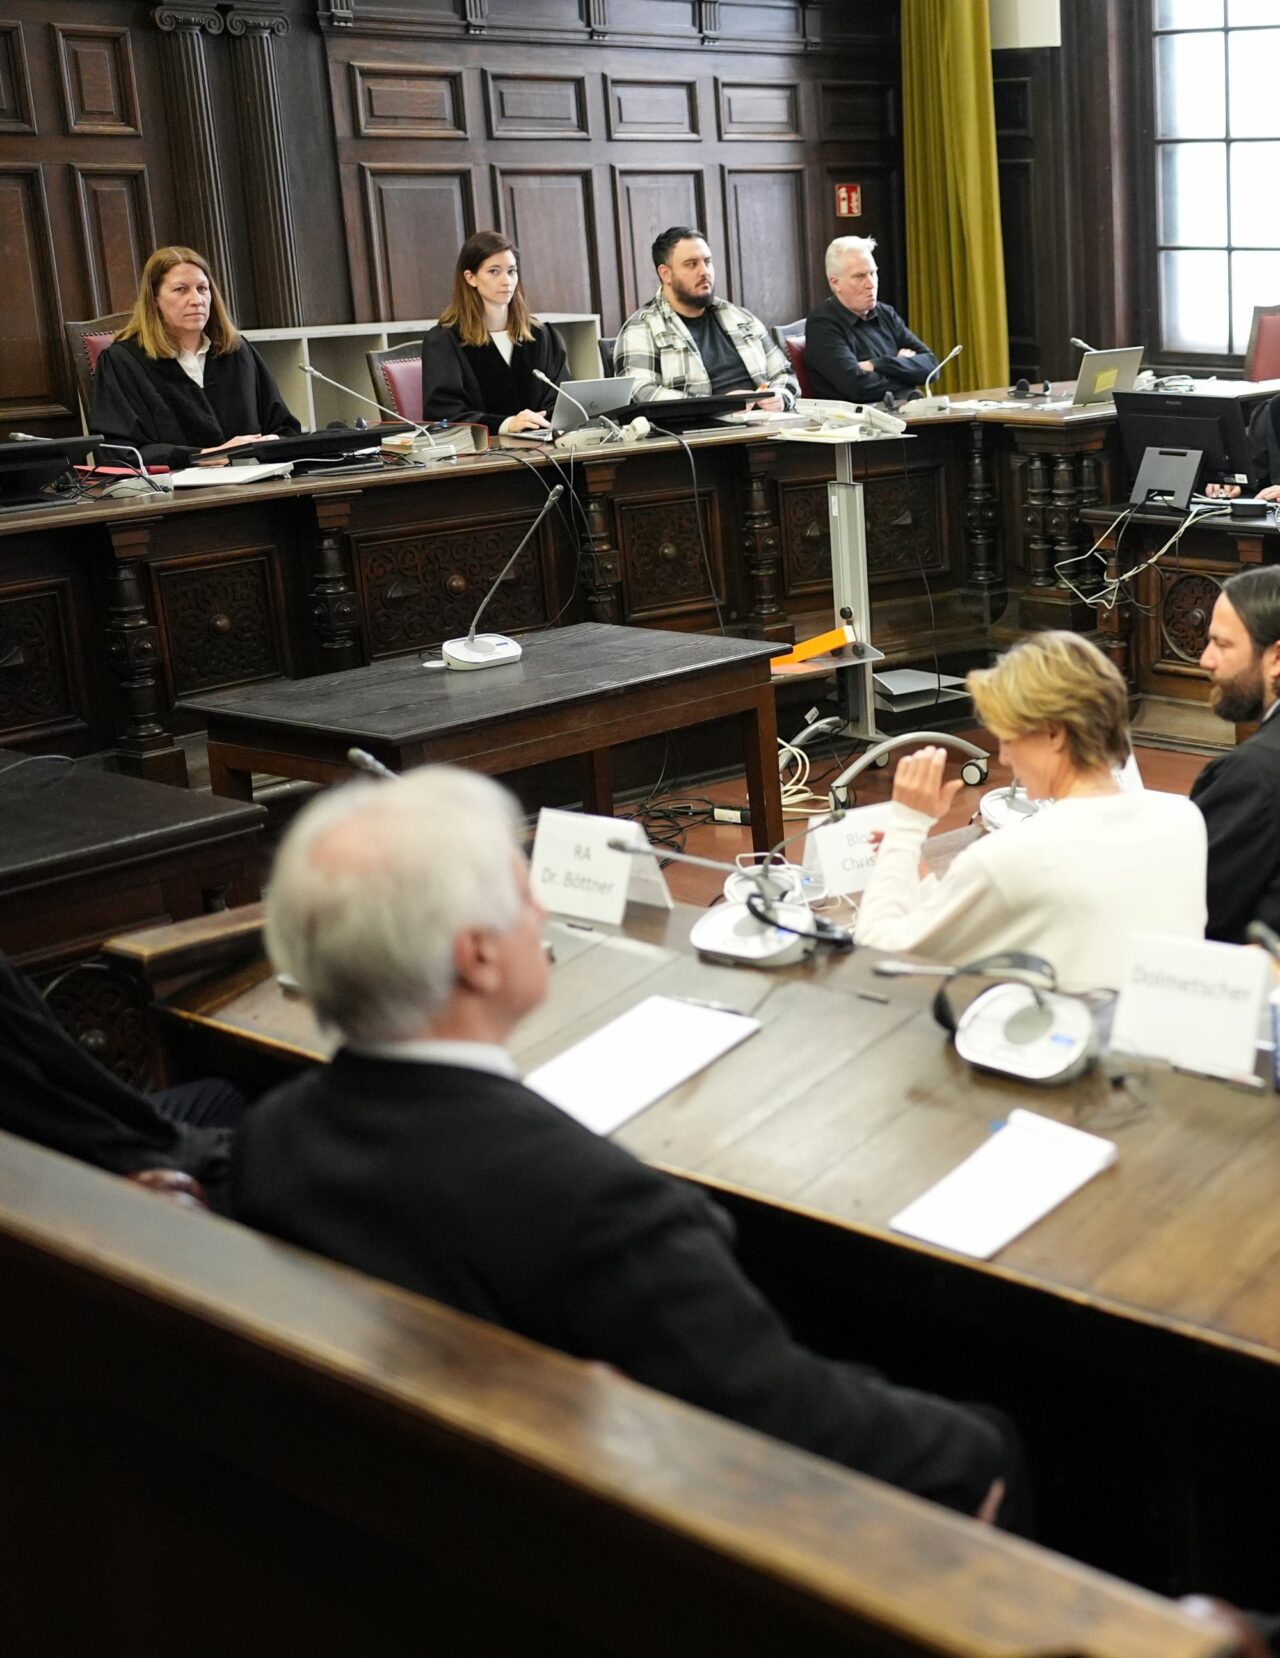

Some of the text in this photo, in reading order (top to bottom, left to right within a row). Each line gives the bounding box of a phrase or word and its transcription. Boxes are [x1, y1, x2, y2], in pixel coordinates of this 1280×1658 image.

[846, 831, 869, 848] Blo
[573, 844, 592, 861] RA
[841, 855, 876, 872] Chris
[541, 866, 615, 895] Dr. Böttner
[1130, 963, 1251, 1002] Dolmetscher
